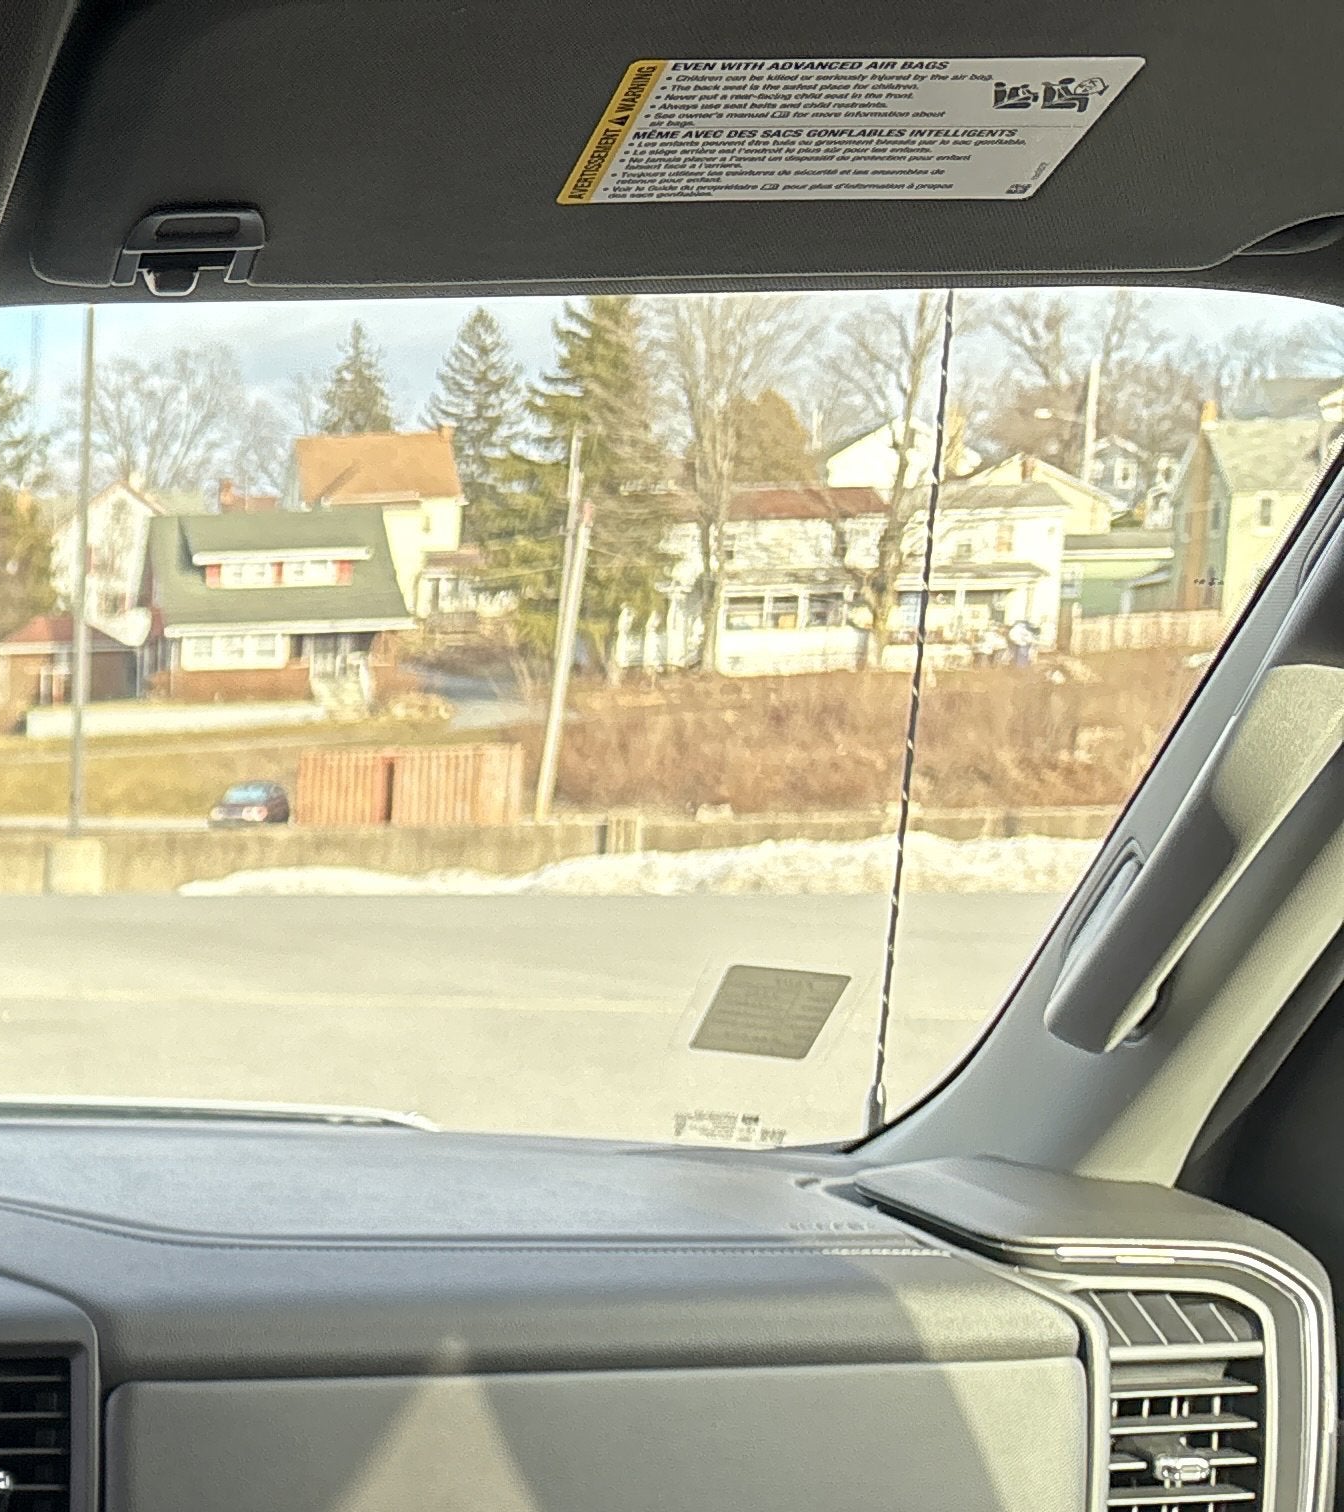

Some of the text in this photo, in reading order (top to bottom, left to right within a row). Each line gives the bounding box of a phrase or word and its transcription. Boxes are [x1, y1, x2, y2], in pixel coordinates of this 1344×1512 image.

[671, 61, 950, 71] EVEN WITH ADVANCED AIR BAGS
[675, 74, 723, 82] Children
[749, 74, 764, 82] be
[815, 74, 868, 82] seriously
[871, 73, 911, 81] injured
[930, 73, 949, 81] the
[615, 65, 657, 113] WARNING
[762, 83, 780, 91] the
[819, 83, 851, 91] place
[664, 93, 697, 101] Never
[698, 93, 720, 101] put
[793, 92, 823, 100] child
[658, 103, 699, 111] Always
[844, 110, 910, 118] information
[632, 128, 1018, 140] MÊME AVEC DES SACS GONFLABLES INTELLIGENTS
[568, 127, 623, 200] AVERTISSEMENT
